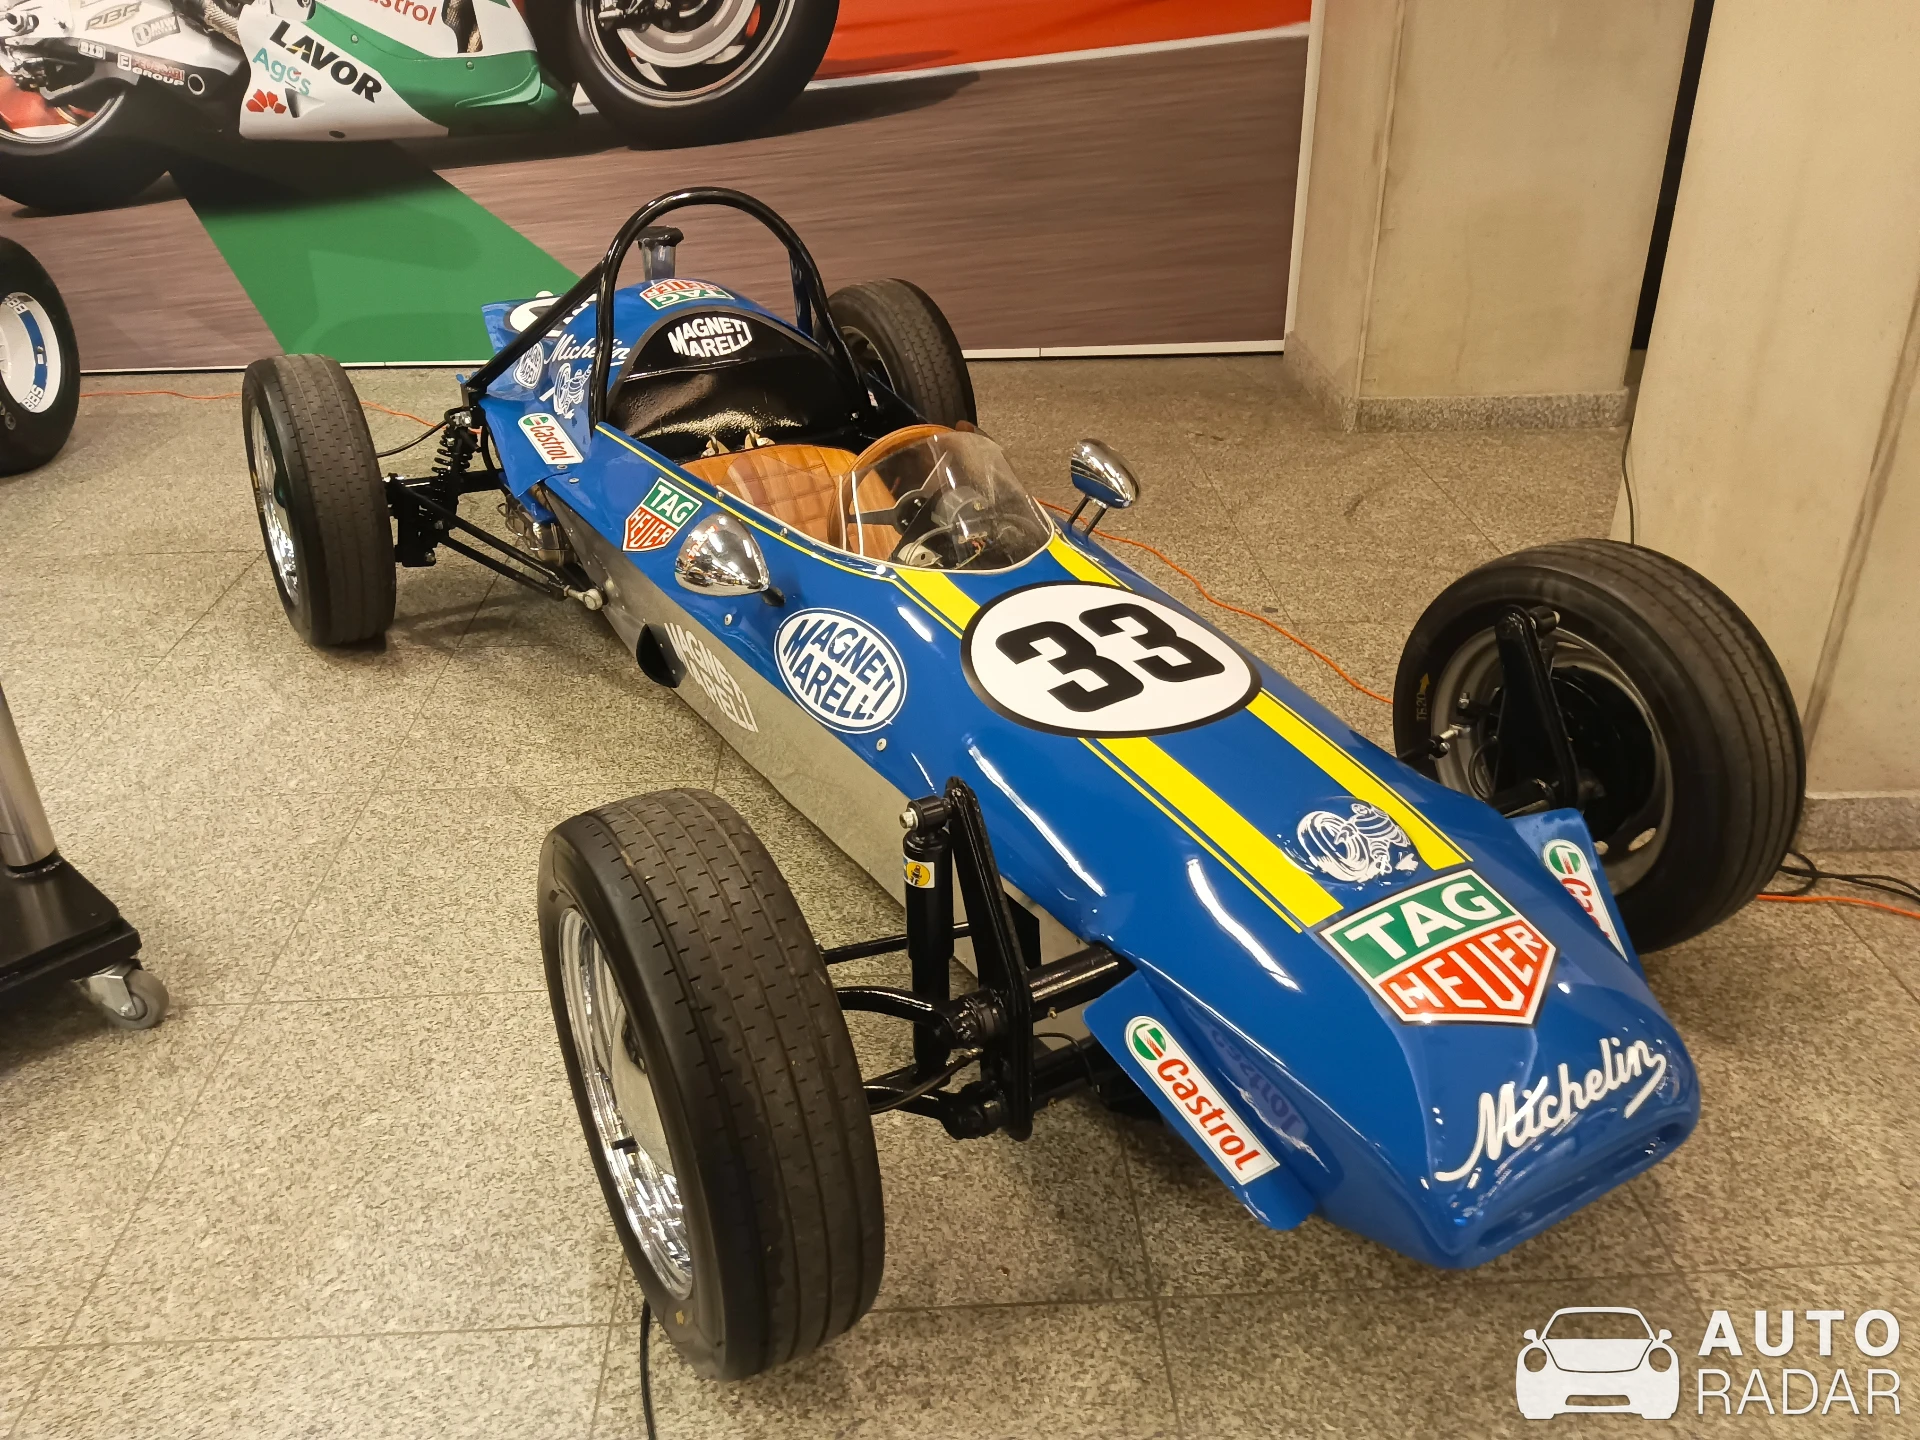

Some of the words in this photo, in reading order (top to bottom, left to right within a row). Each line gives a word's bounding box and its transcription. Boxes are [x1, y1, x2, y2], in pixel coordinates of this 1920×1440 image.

[132, 66, 185, 86] GROUP
[252, 47, 312, 95] Agos
[270, 19, 382, 104] LAVOR
[655, 288, 726, 306] TAG
[544, 334, 631, 365] Michein
[667, 316, 753, 345] MAGNETI
[667, 327, 753, 358] MARELLI
[22, 384, 44, 411] BBS
[530, 425, 575, 461] Castrol
[650, 485, 694, 524] TAG
[629, 509, 674, 548] HEUER
[782, 618, 896, 702] MAGNETI
[994, 602, 1226, 713] 33
[782, 640, 895, 721] MARELLI
[1344, 882, 1502, 961] TAG
[1388, 924, 1544, 1012] HEUER
[1157, 1057, 1261, 1171] Castrol
[1434, 1037, 1667, 1182] Michelin
